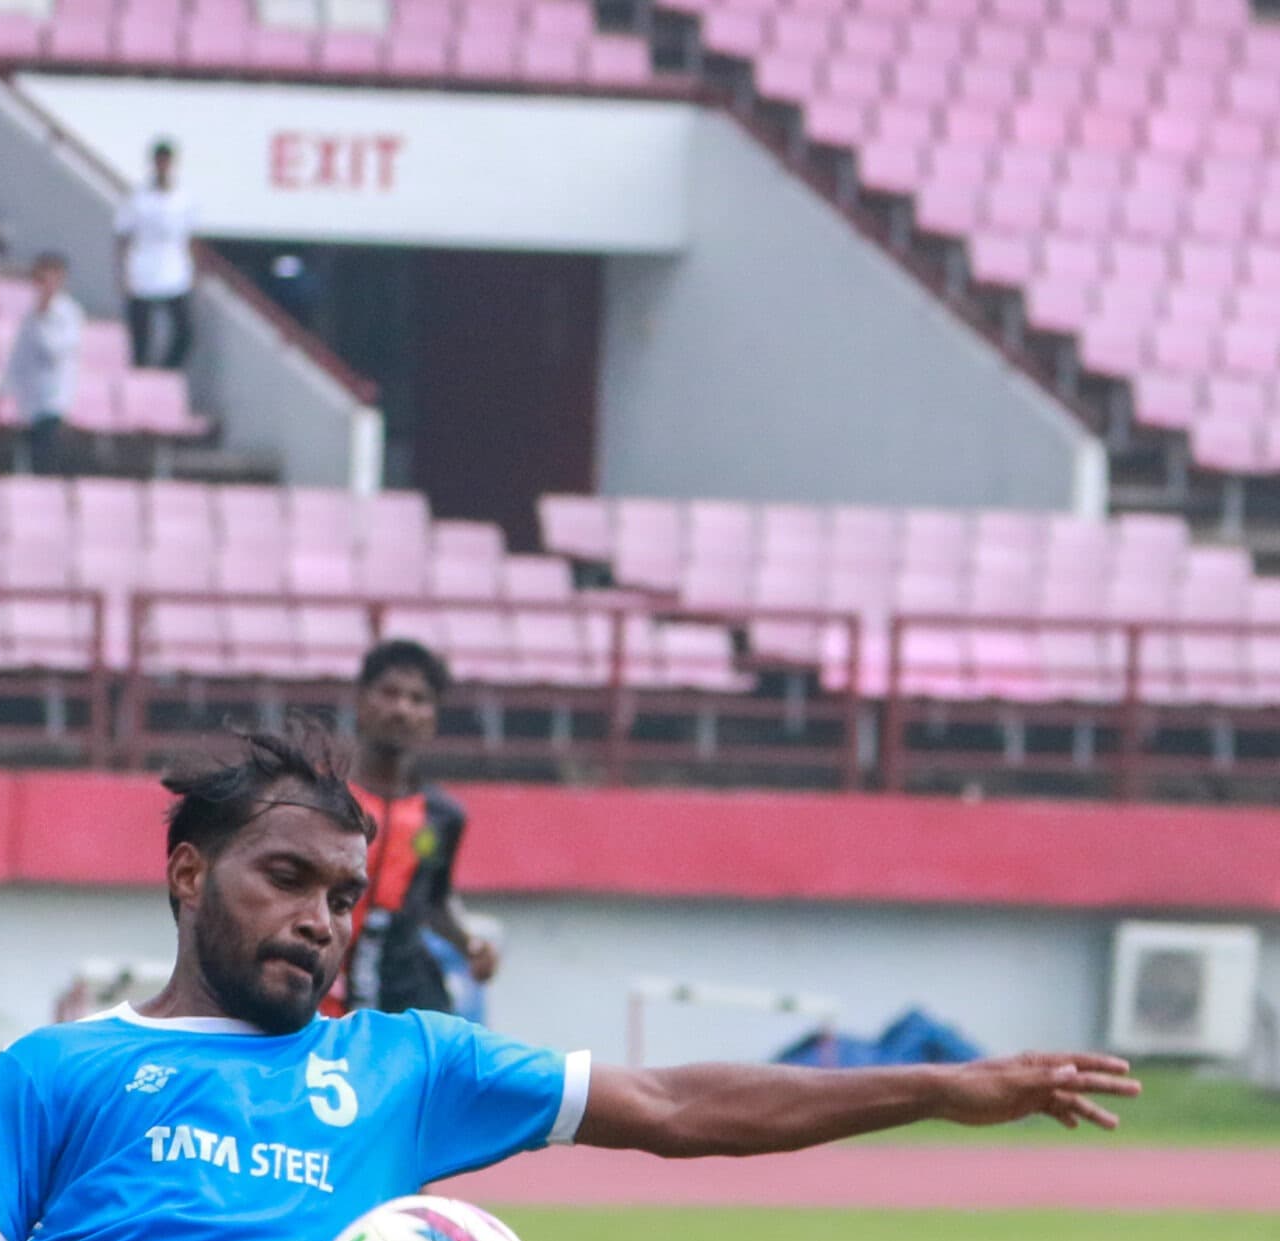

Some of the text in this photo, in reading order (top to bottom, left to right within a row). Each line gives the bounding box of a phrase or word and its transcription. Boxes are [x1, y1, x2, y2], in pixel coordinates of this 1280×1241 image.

[269, 132, 406, 190] EXIT
[305, 1052, 359, 1127] 5
[145, 1125, 334, 1193] TATA STEEL
